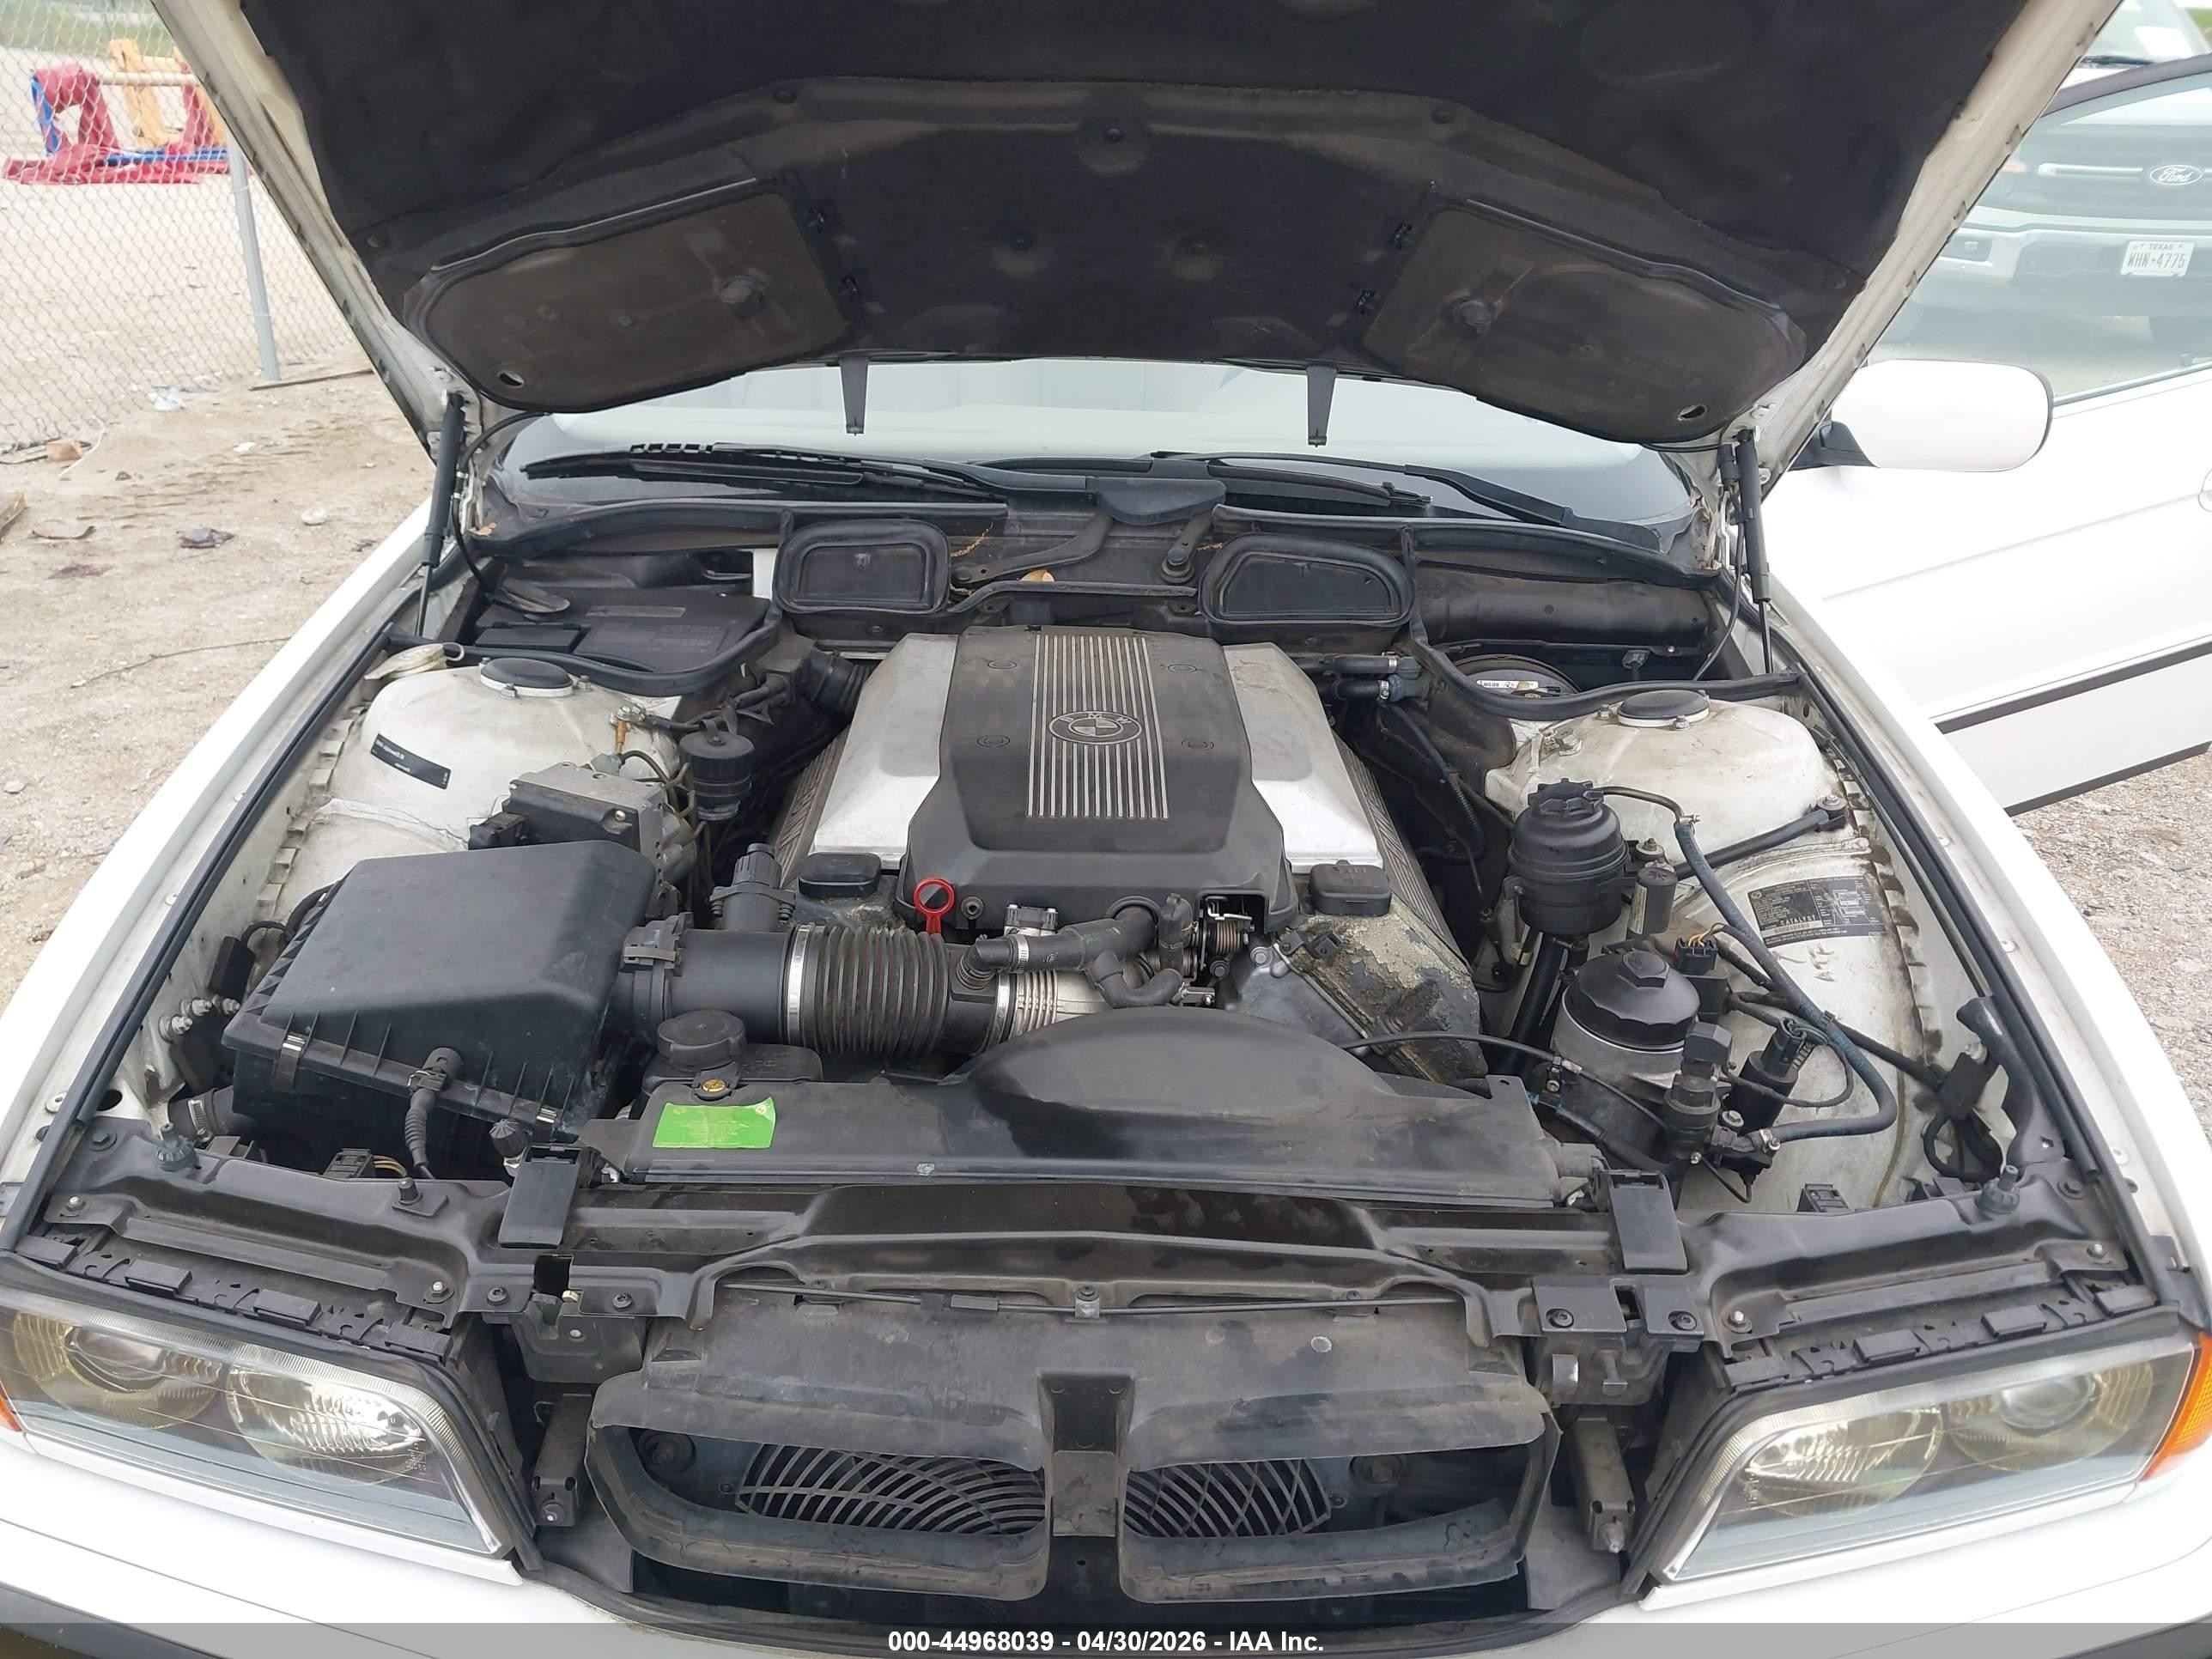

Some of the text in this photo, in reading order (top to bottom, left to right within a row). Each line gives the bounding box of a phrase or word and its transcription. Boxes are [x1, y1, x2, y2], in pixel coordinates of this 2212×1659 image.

[2158, 167, 2193, 182] Ford
[1059, 712, 1133, 724] BMW
[1780, 914, 1817, 927] CATALYST
